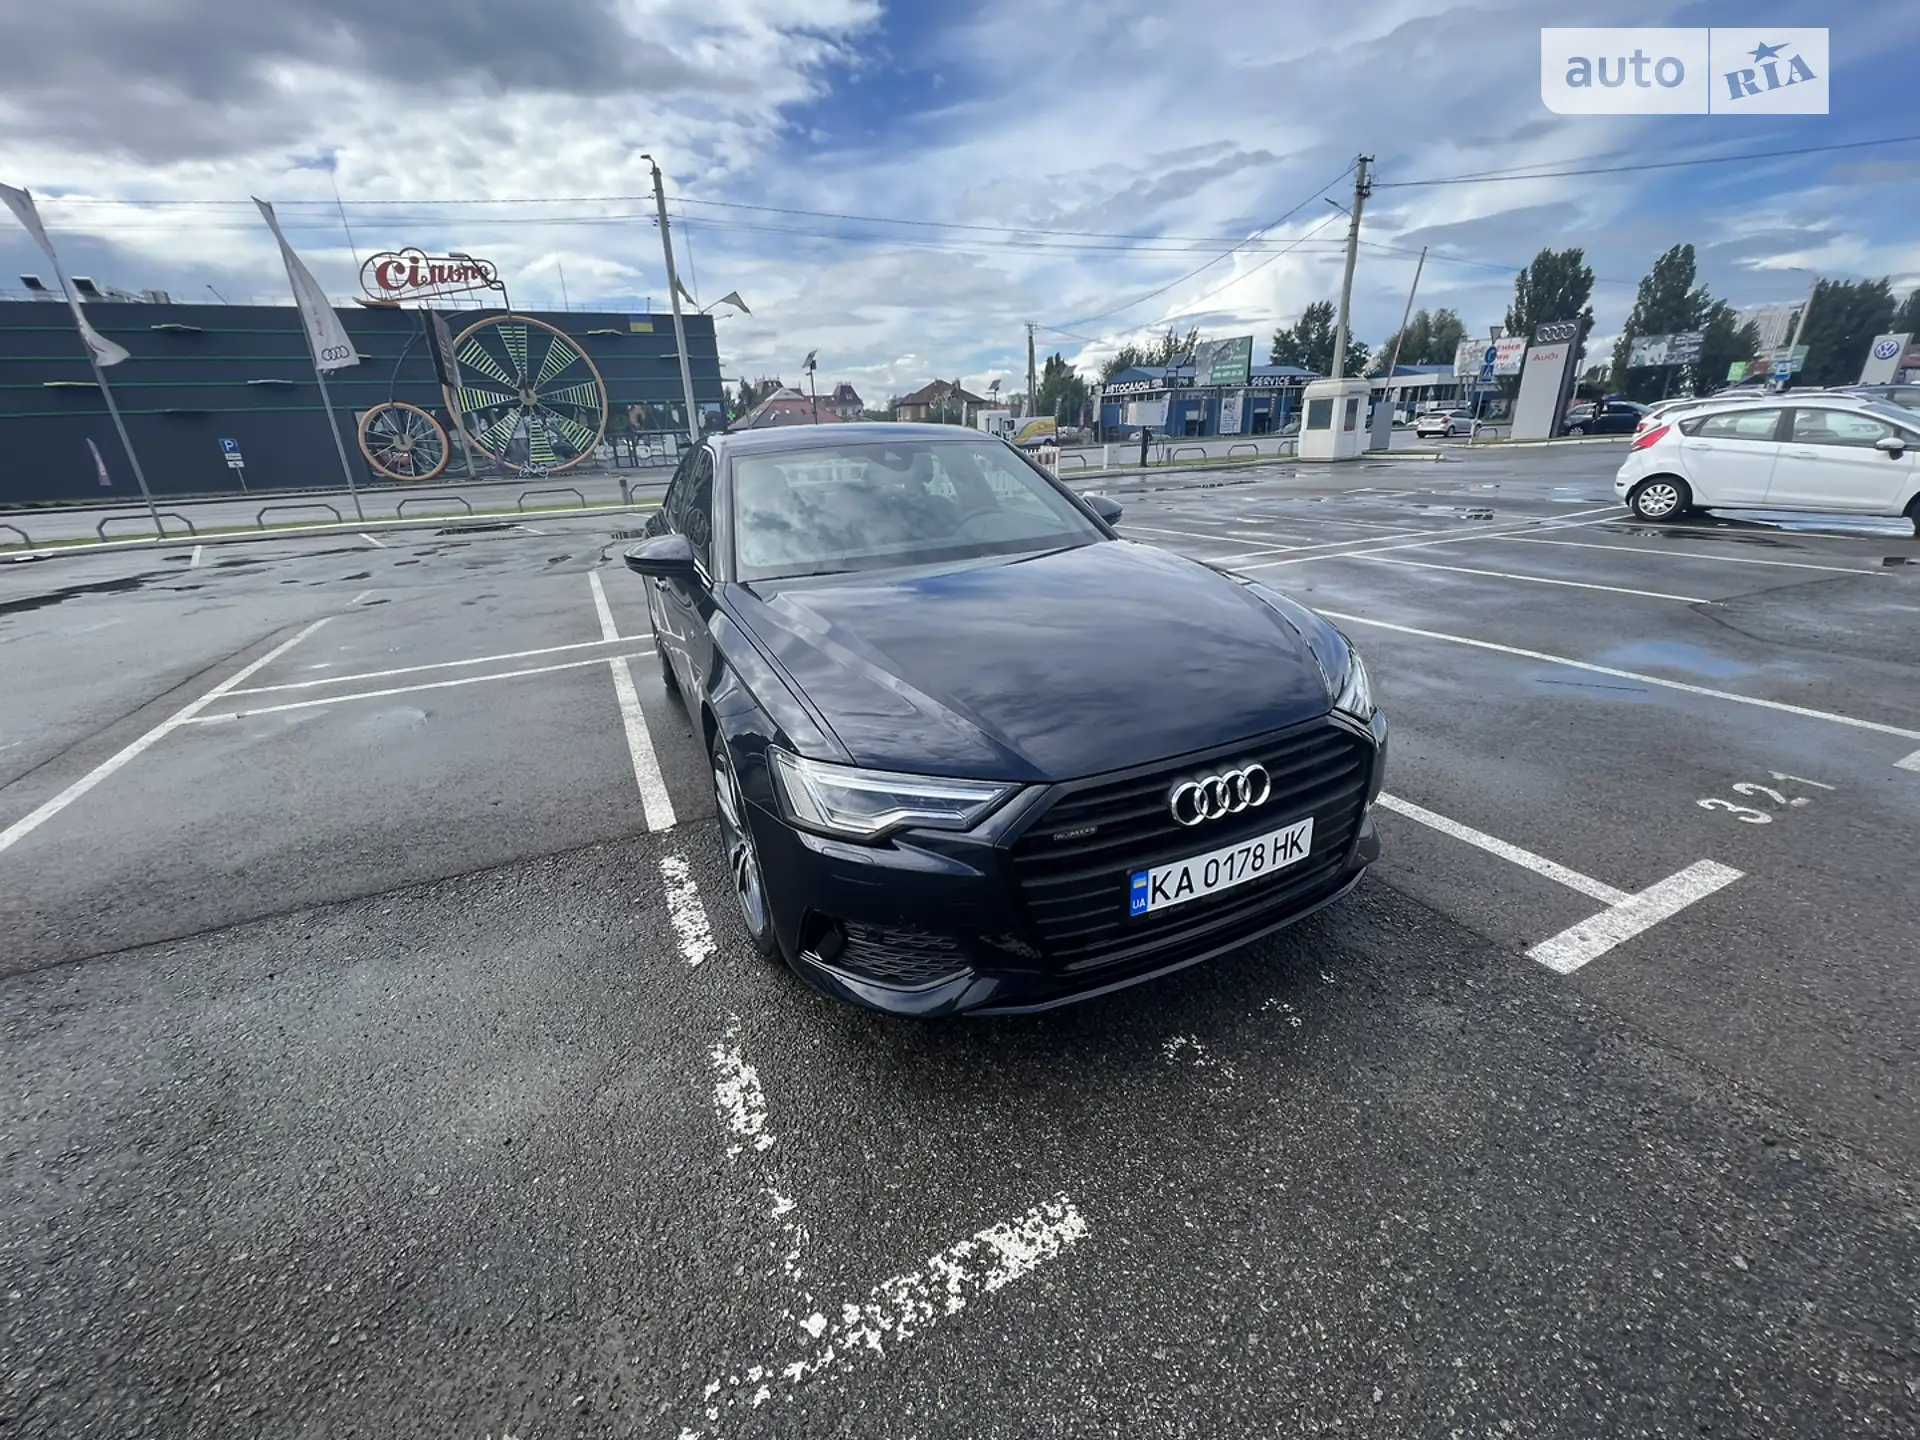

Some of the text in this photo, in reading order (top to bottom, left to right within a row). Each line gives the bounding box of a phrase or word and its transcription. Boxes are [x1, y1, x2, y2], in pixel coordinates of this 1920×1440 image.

[1532, 352, 1559, 361] Audi
[1251, 376, 1290, 387] SERVICE
[1151, 866, 1195, 905] KA
[1204, 842, 1266, 888] 0178
[1272, 825, 1307, 865] HK
[1132, 898, 1146, 910] UA
